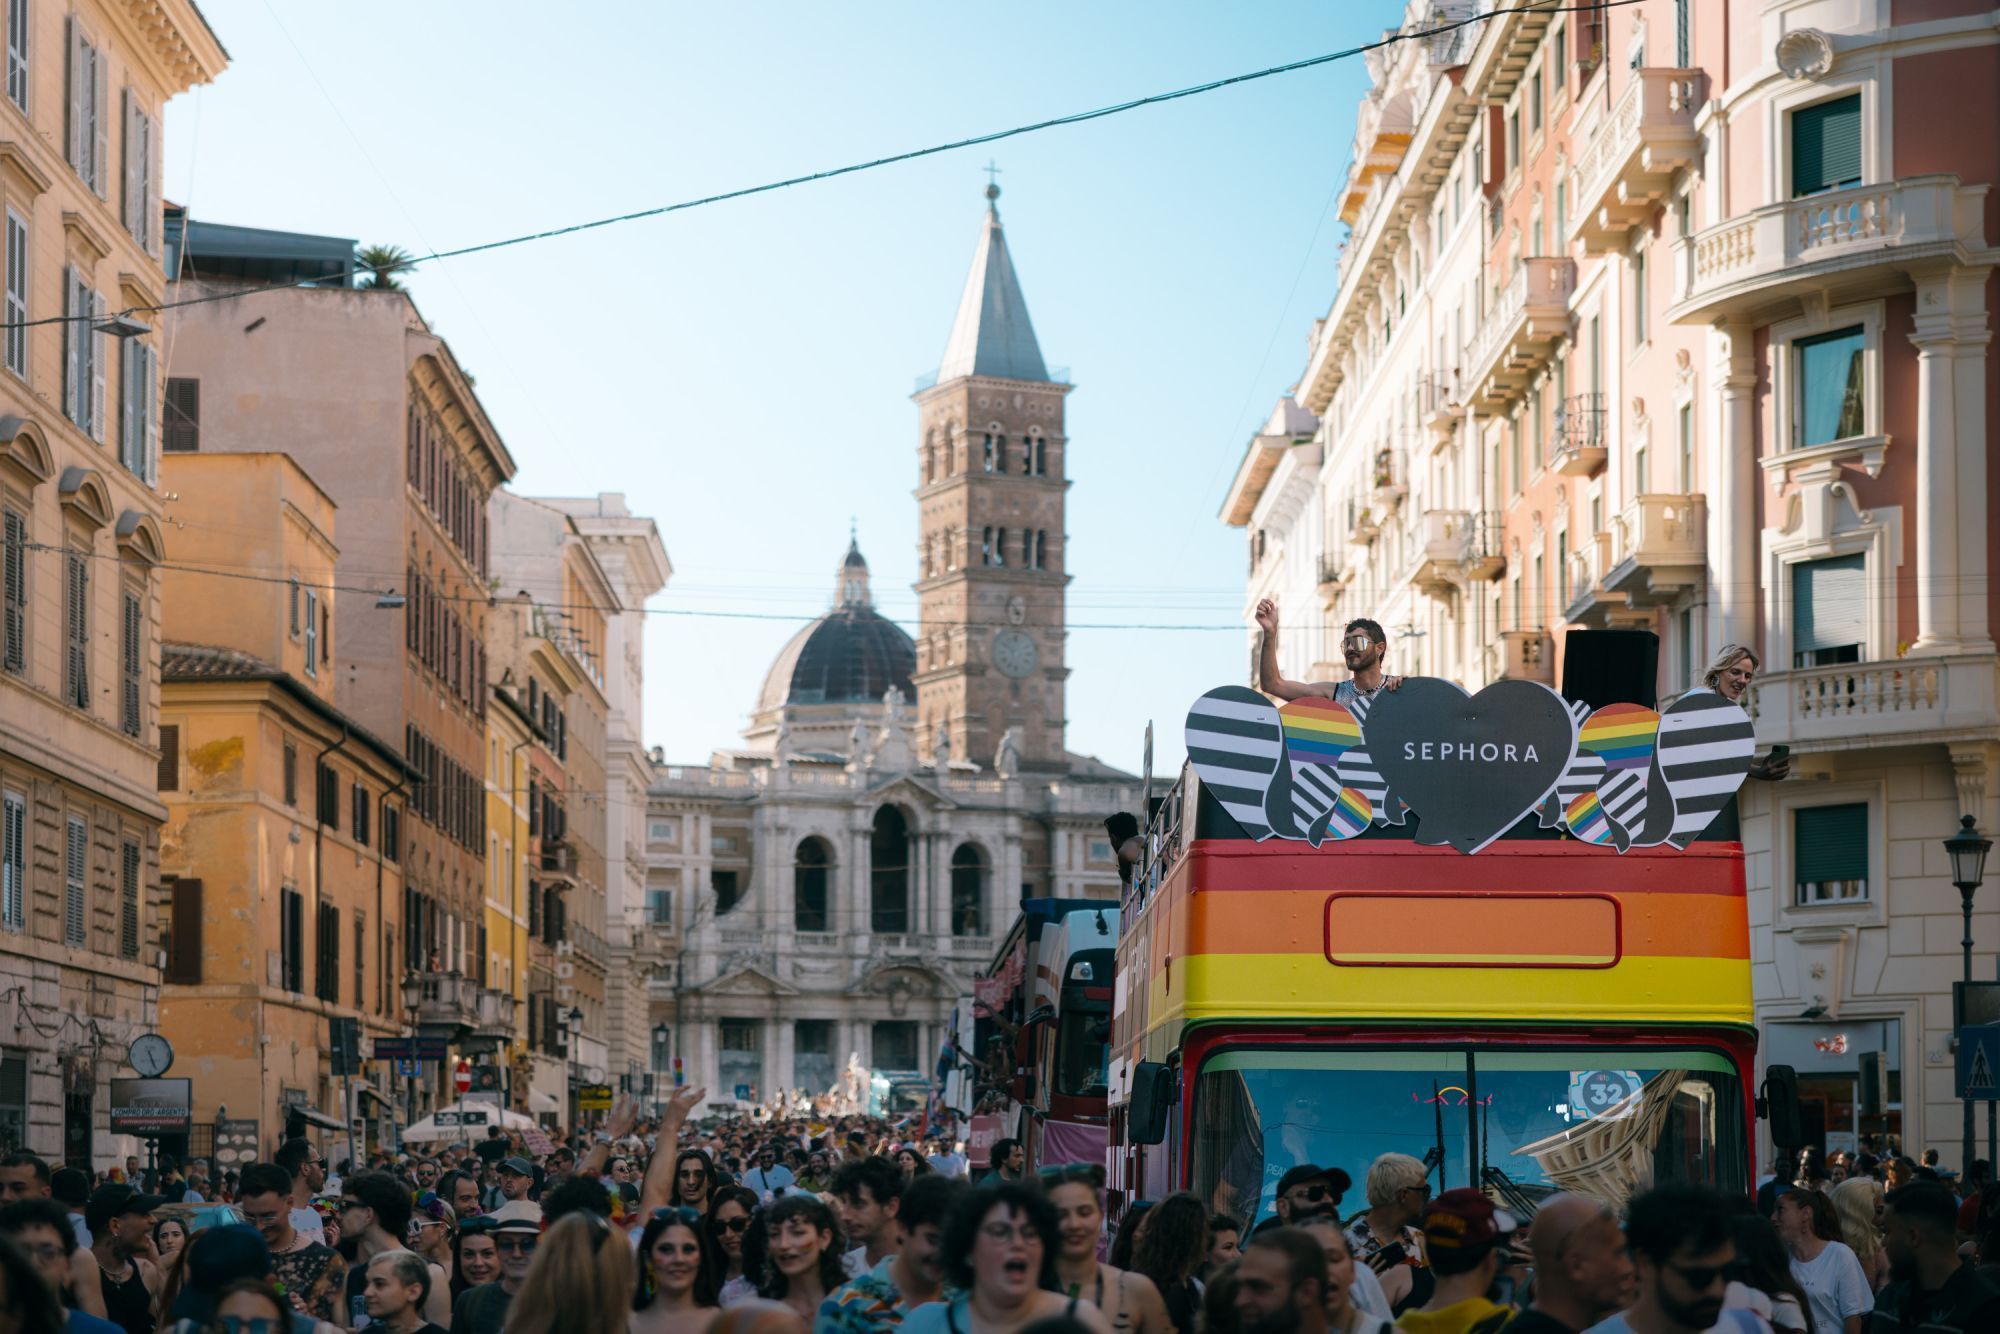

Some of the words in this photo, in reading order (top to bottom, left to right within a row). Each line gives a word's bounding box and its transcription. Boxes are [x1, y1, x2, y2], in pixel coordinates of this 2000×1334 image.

[1403, 741, 1539, 763] SEPHORA
[556, 939, 575, 1046] HOTEL
[1590, 1083, 1624, 1105] 32
[114, 1107, 141, 1116] COMPRO
